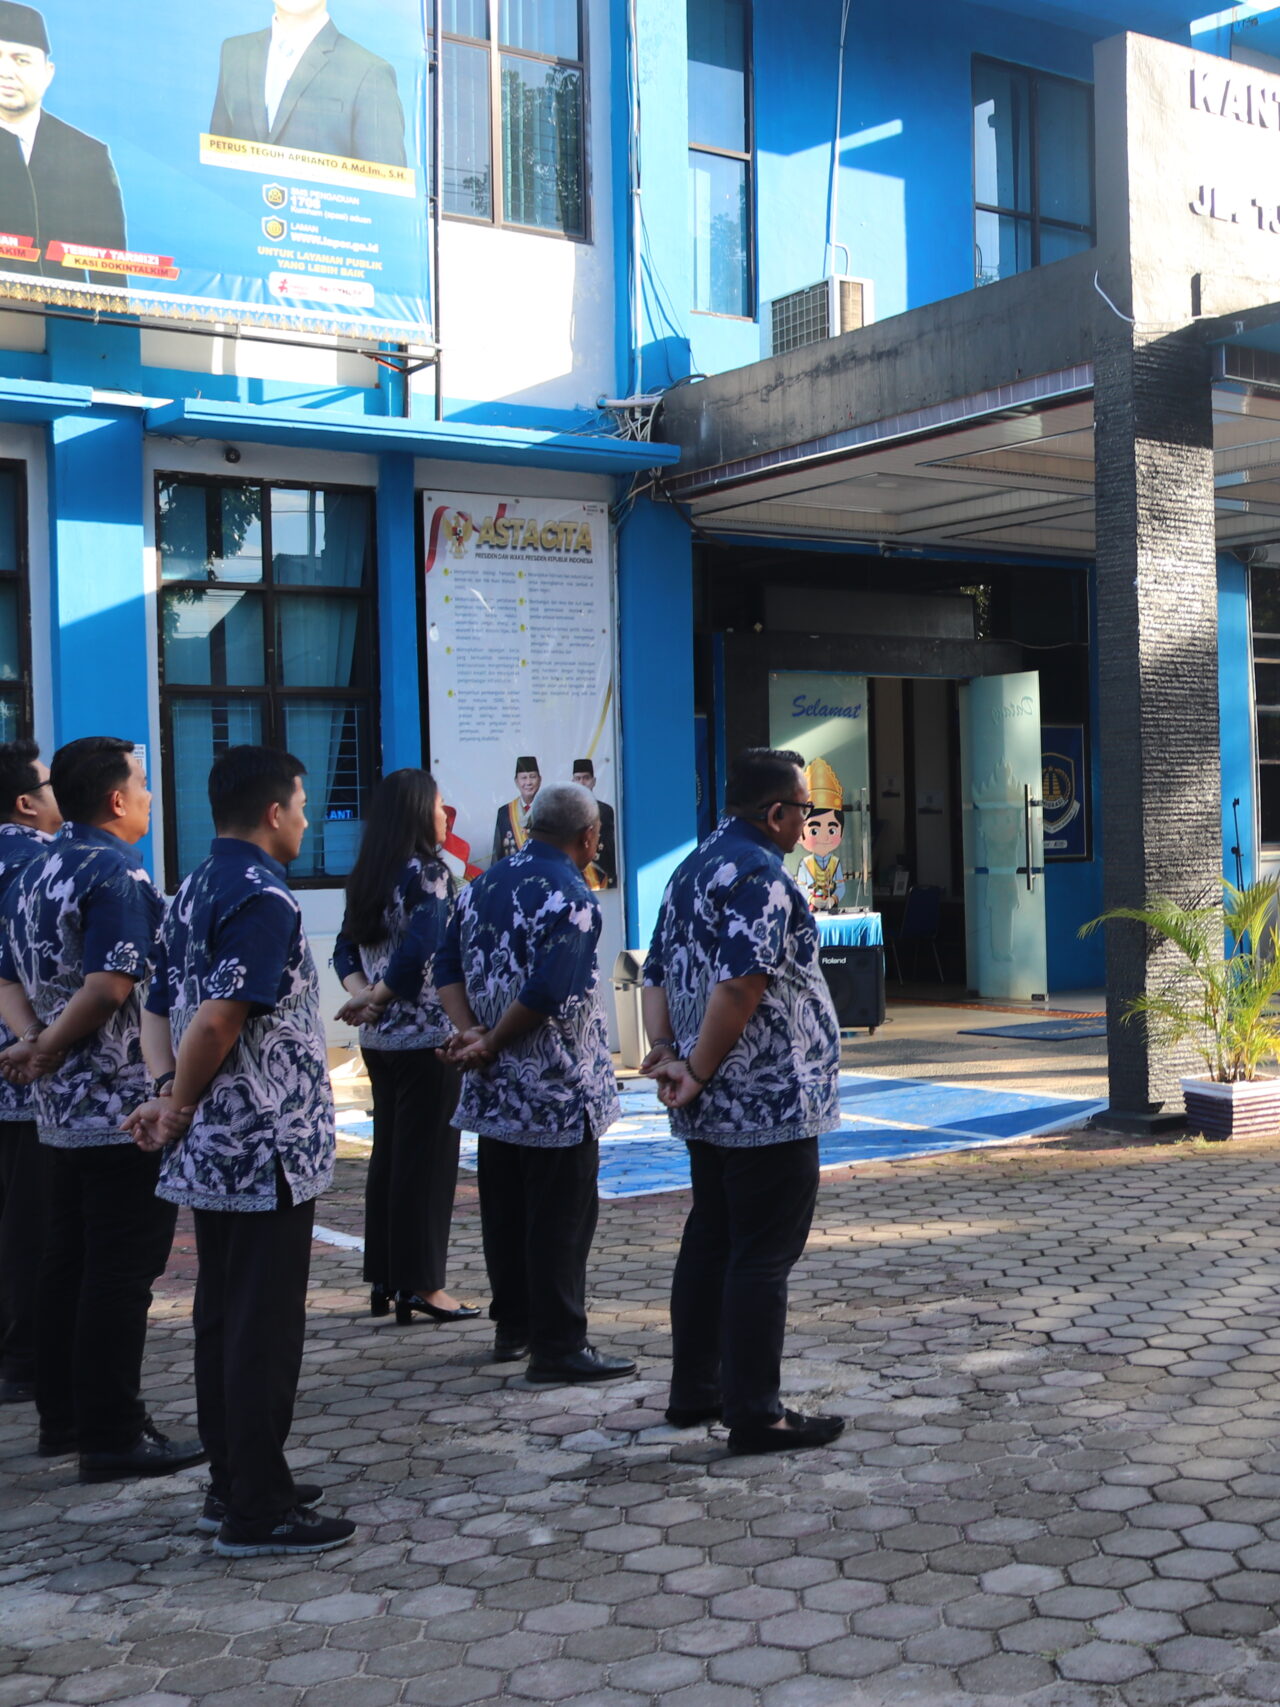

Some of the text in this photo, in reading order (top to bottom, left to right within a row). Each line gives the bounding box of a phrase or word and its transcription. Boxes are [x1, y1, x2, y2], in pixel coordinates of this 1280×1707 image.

[209, 140, 248, 154] PETRUS
[250, 146, 285, 159] TEGUH
[288, 152, 339, 169] APRIANTO
[0, 235, 18, 247] AN
[74, 257, 98, 268] KASI
[257, 246, 383, 270] UNTUK LAYANAN PUBLIK
[277, 259, 366, 279] YANG LEBIH BAIK
[791, 694, 863, 719] Selamat
[821, 957, 847, 965] Roland
